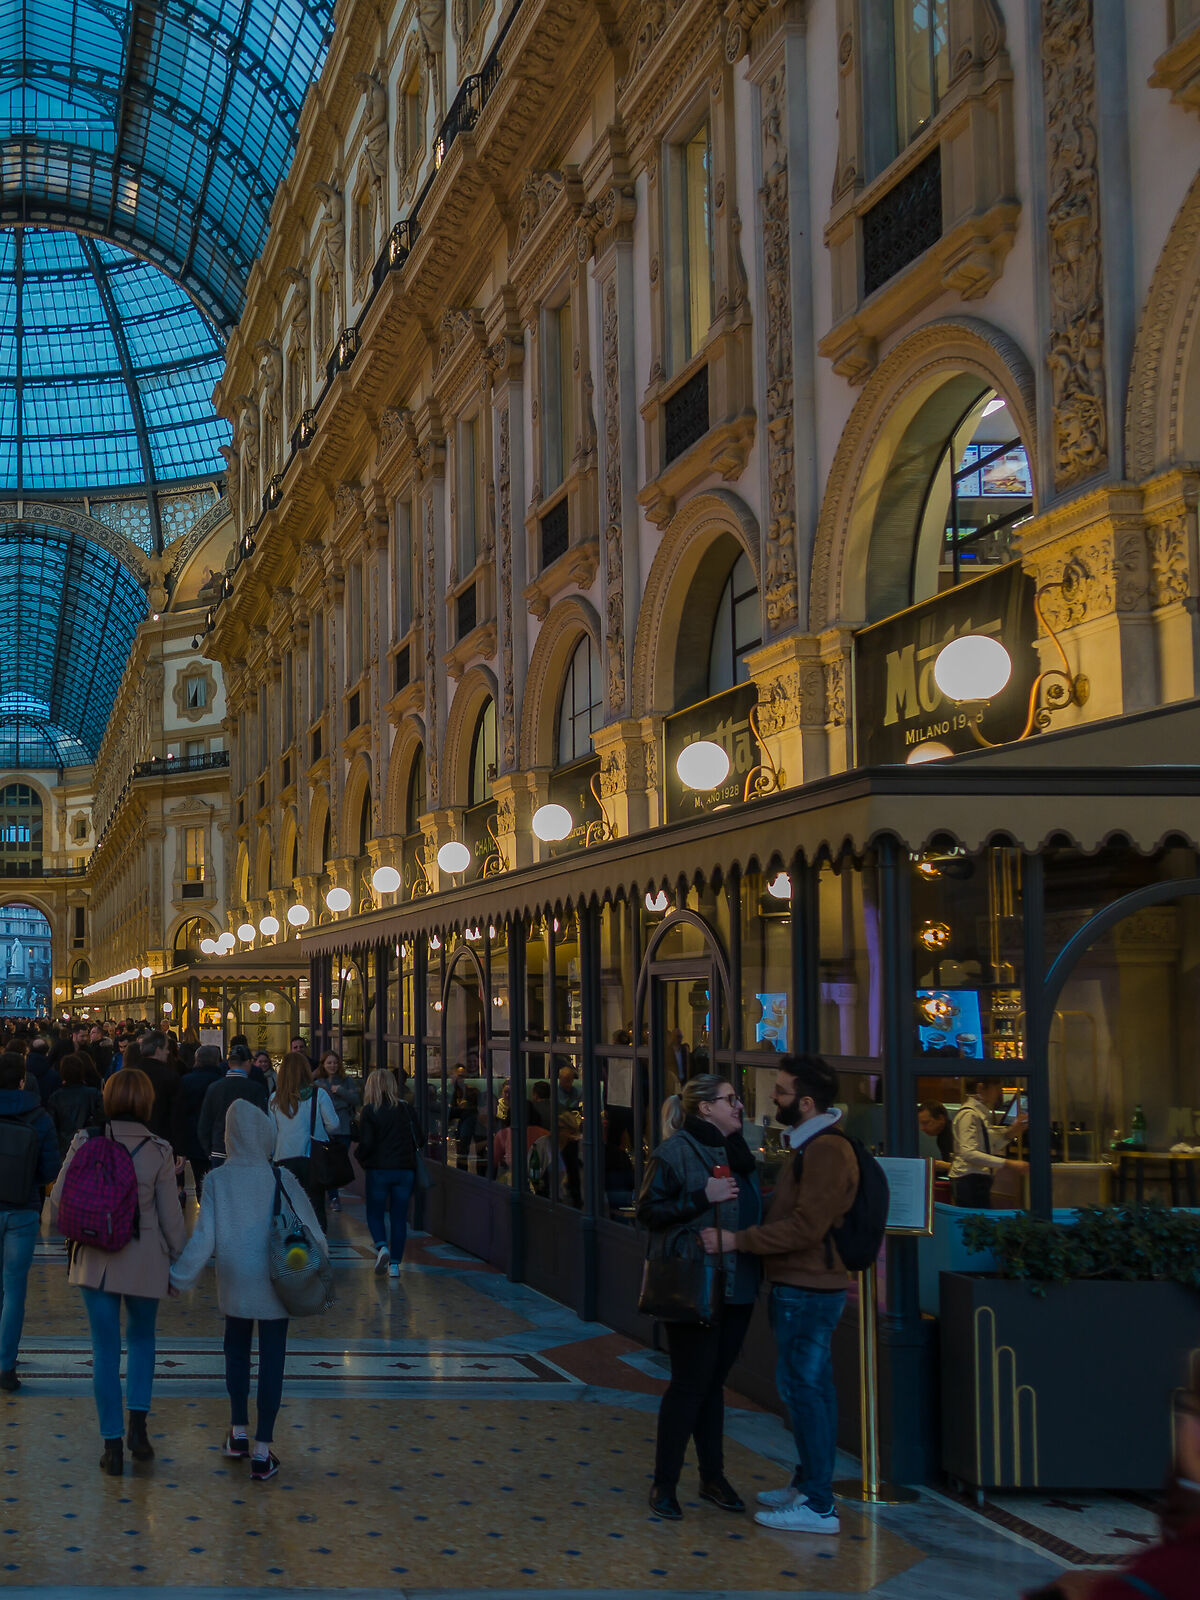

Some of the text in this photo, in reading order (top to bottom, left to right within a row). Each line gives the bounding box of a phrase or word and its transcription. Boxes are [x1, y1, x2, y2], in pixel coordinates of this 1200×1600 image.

[905, 708, 984, 745] MILANO 198
[694, 784, 739, 808] MANO 1928
